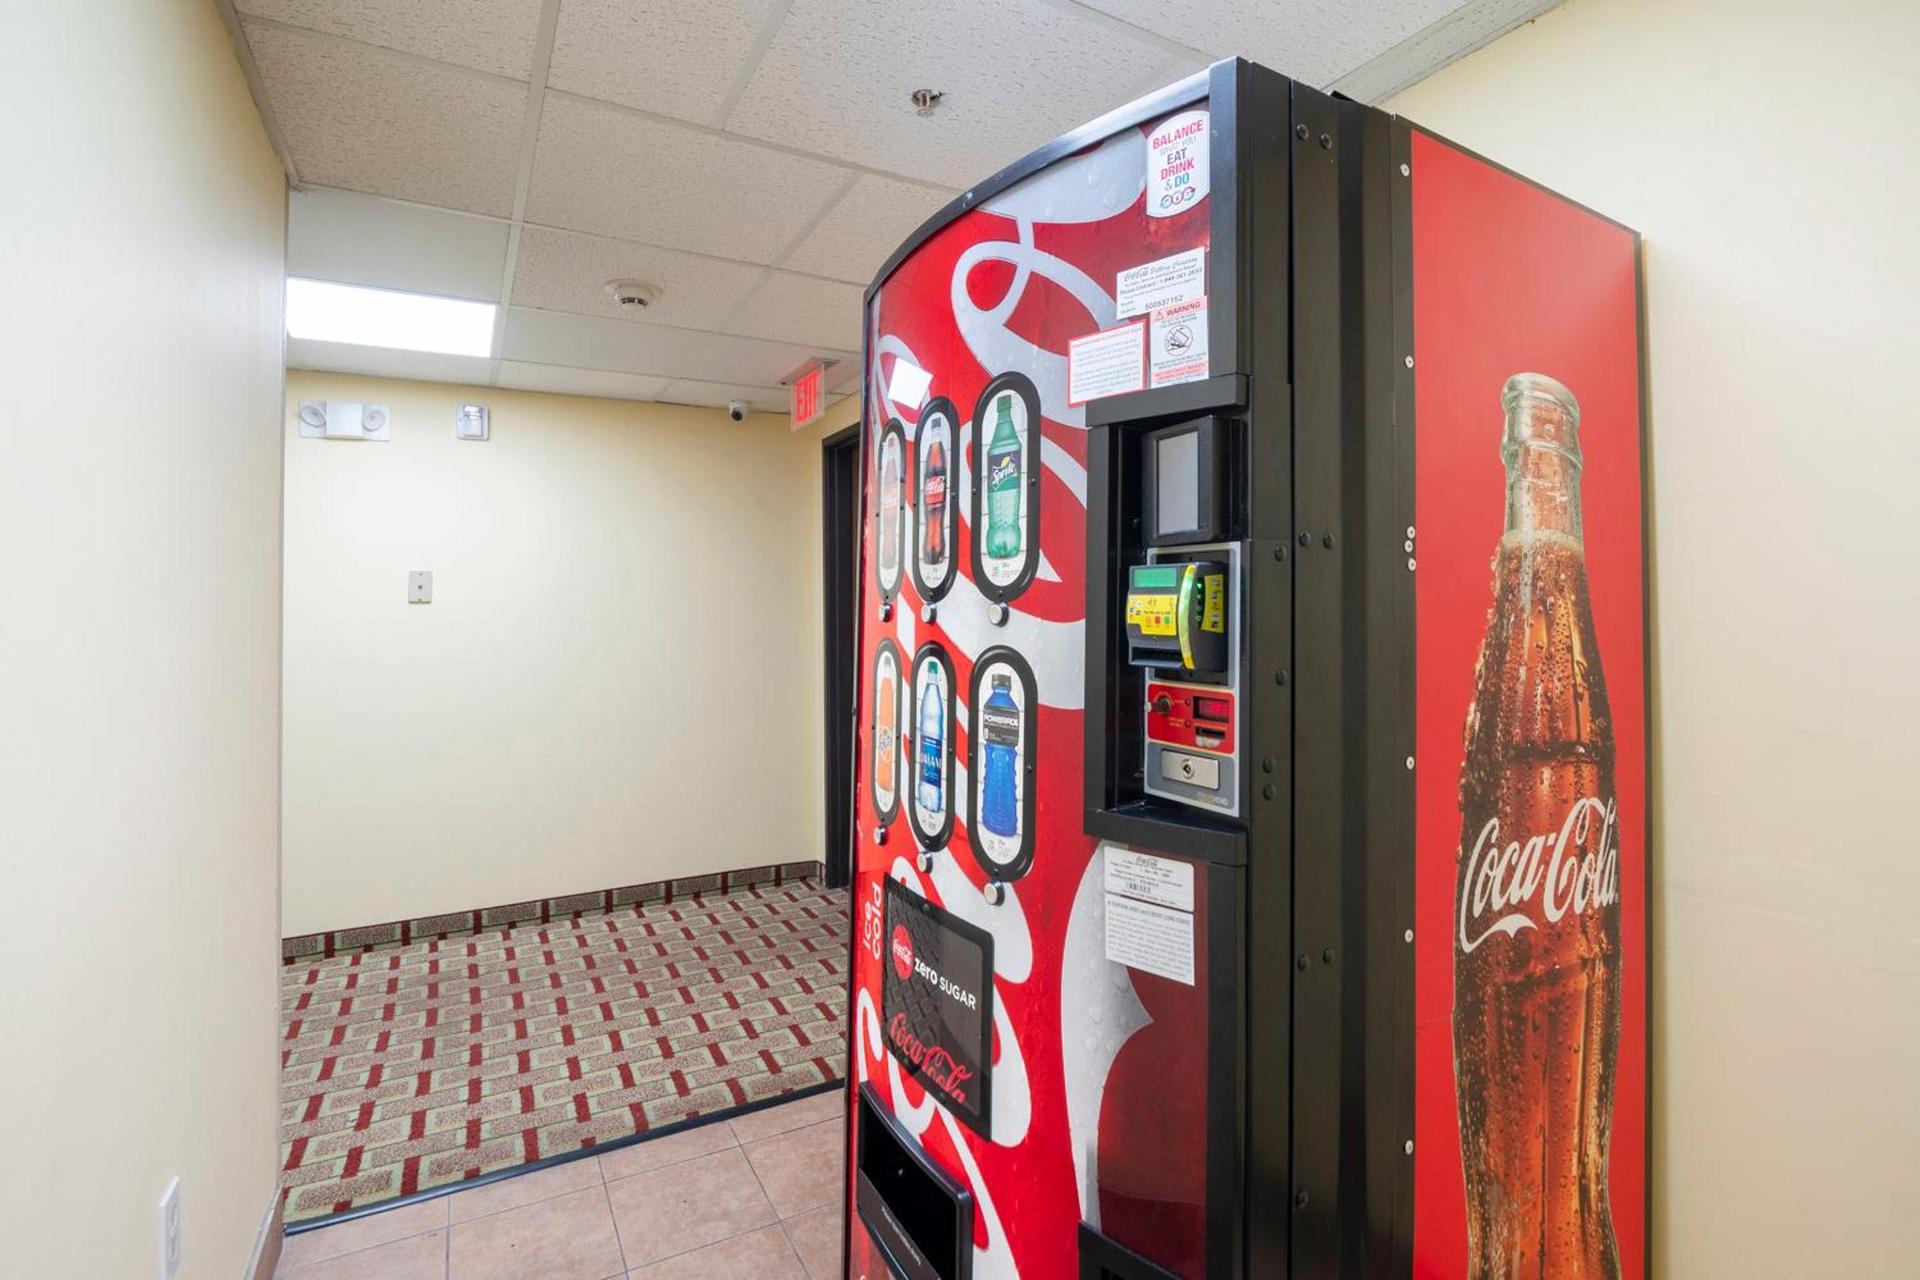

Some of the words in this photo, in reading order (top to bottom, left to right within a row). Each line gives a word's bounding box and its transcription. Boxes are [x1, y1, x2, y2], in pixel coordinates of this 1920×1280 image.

[1152, 120, 1204, 149] BALANCE
[1161, 157, 1195, 180] DRINK
[1167, 147, 1187, 165] EAT
[1165, 179, 1173, 191] &
[1174, 172, 1190, 187] DO
[1166, 302, 1201, 316] WARNING
[796, 370, 820, 422] EXIT
[992, 461, 1017, 485] Sprite
[1459, 797, 1618, 953] Coca-Cola
[872, 880, 882, 961] cold
[915, 957, 938, 985] zero
[939, 976, 977, 1011] SUGAR
